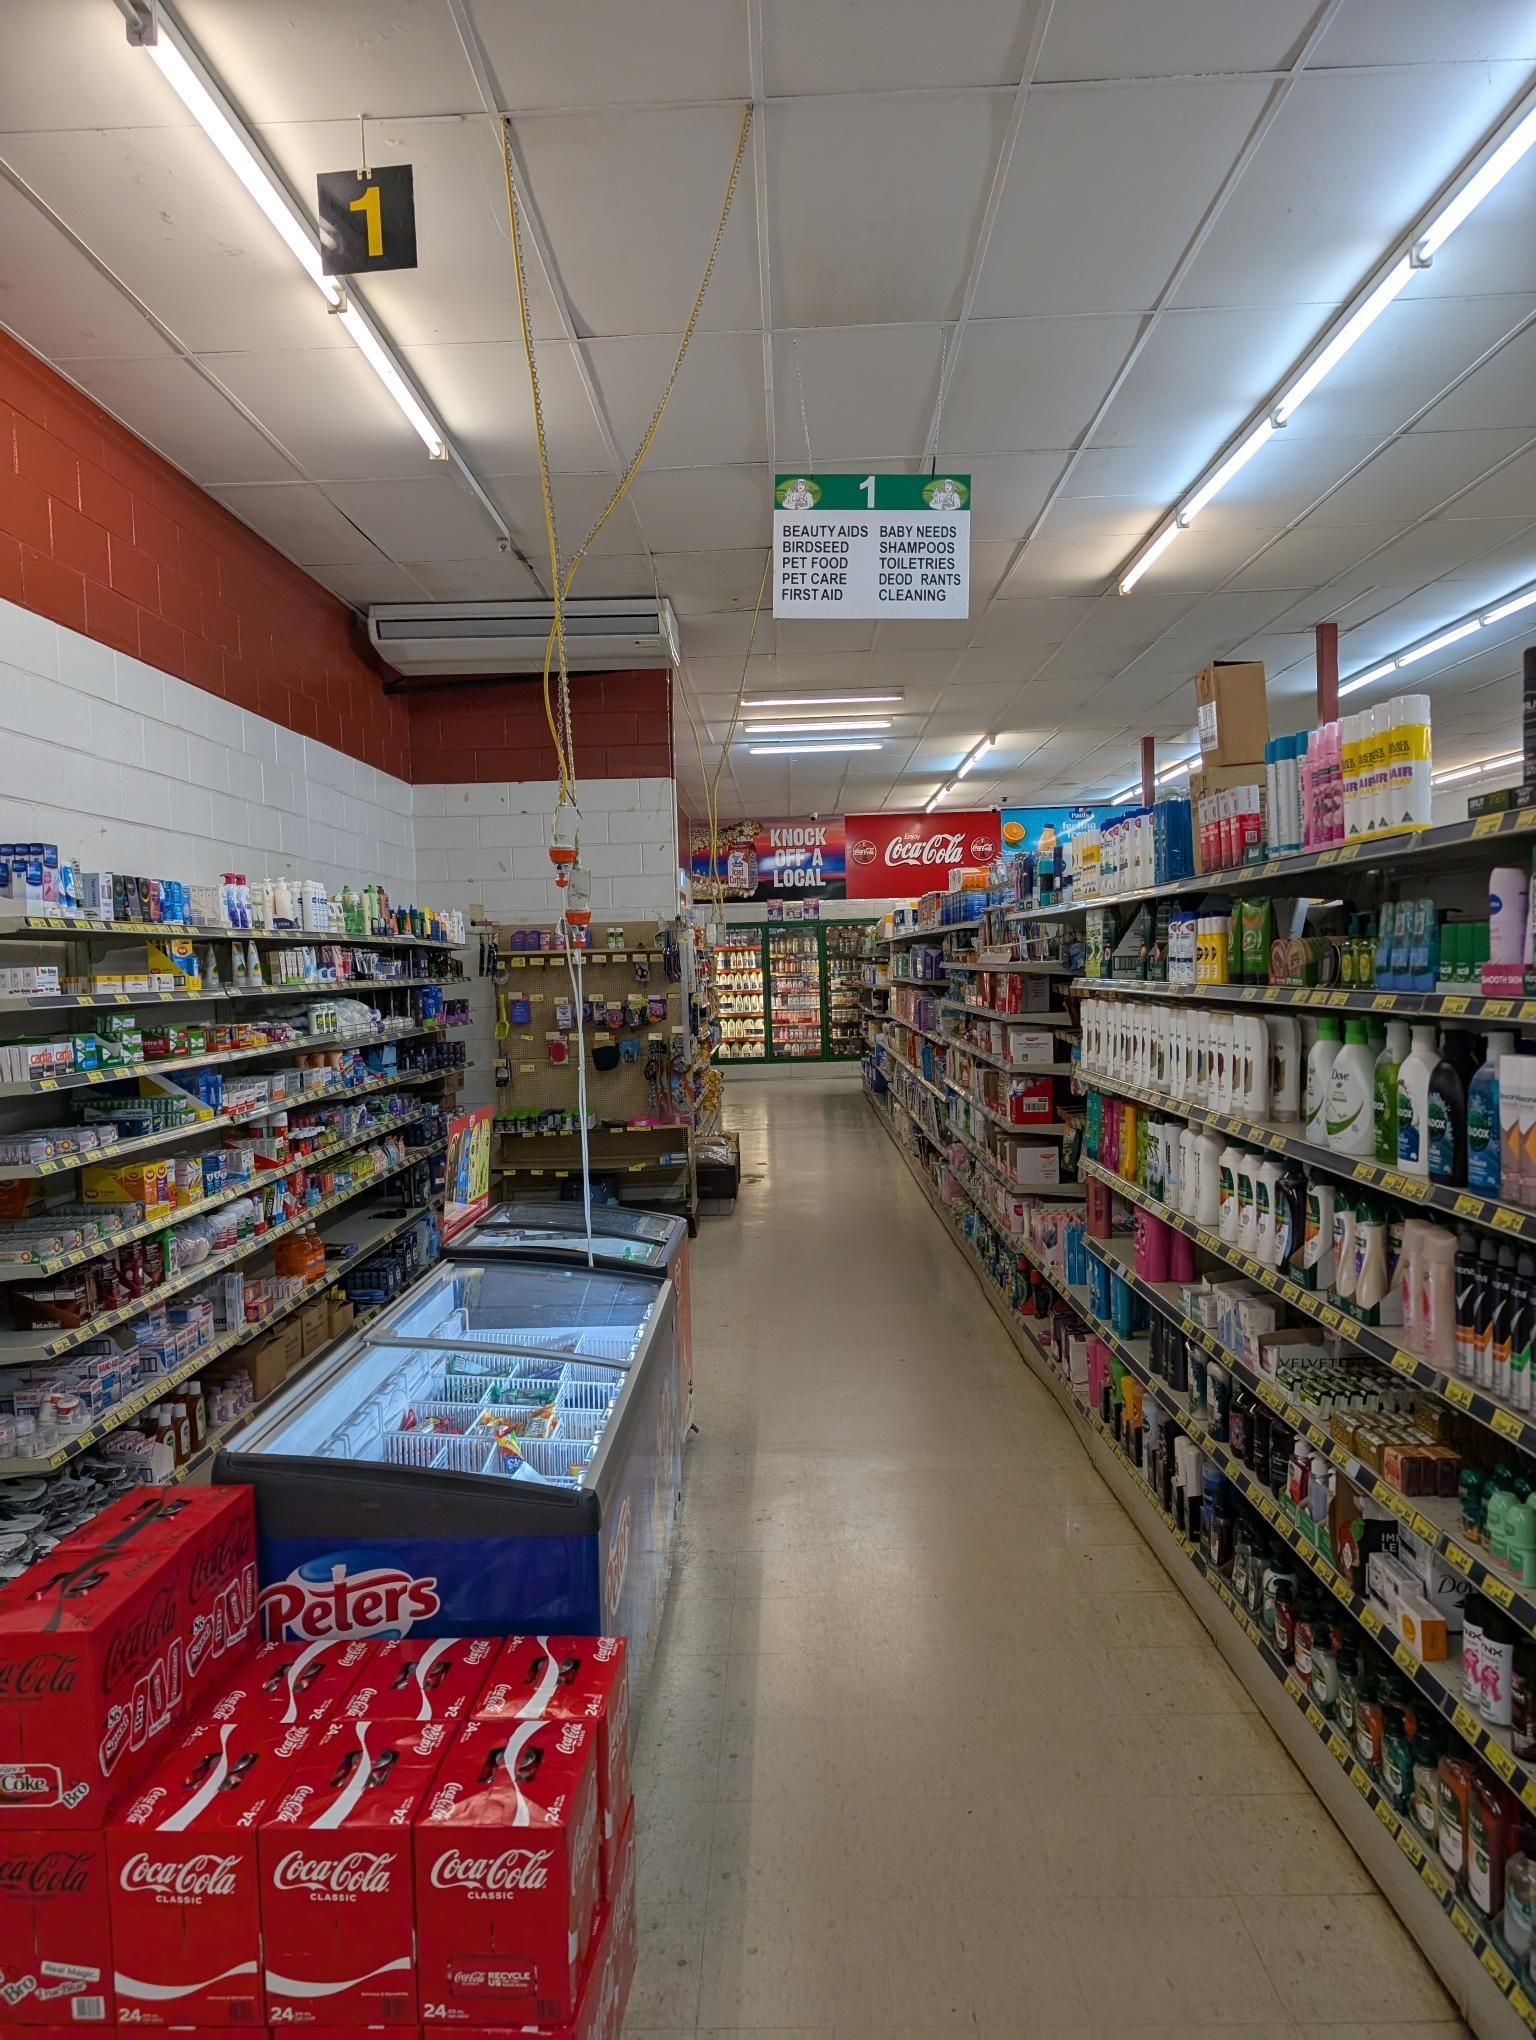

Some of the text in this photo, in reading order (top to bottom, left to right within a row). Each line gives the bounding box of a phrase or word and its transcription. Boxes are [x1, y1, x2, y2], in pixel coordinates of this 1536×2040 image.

[350, 186, 384, 257] 1
[858, 475, 877, 509] 1
[782, 525, 869, 538] BEAUTY AIDS
[879, 525, 957, 538] BABY NEEDS
[782, 541, 850, 554] BIRDSEED
[879, 542, 955, 554] SHAMPOOS
[782, 557, 849, 570] PET FOOD
[879, 557, 955, 570] TOILETRIES
[781, 573, 848, 585] PET CARE
[781, 589, 844, 601] FIRST AID
[878, 589, 947, 602] CLEANING
[770, 828, 827, 847] KNOCK
[904, 832, 921, 841] Enjoy
[884, 832, 966, 867] Coca-Cola
[775, 848, 824, 868] OFF A
[731, 867, 744, 876] Iced
[773, 868, 827, 888] LOCAL
[728, 875, 748, 885] Coffee
[30, 1047, 53, 1065] cartia
[55, 1045, 73, 1063] cartia
[1331, 1070, 1350, 1081] Dove
[32, 1320, 62, 1329] Betadine
[97, 1358, 119, 1373] BAND-AID
[1438, 1574, 1474, 1594] Dov
[258, 1566, 439, 1642] Peters
[555, 1722, 583, 1755] Coca-Cola
[62, 1783, 89, 1808] Bro
[119, 1852, 244, 1895] Coca-Cola
[273, 1850, 398, 1893] Coca-Cola
[430, 1848, 555, 1890] Coca-Cola
[155, 1895, 203, 1905] CLASSIC
[309, 1892, 357, 1902] CLASSIC
[467, 1891, 515, 1900] CLASSIC
[487, 1971, 531, 1981] RECYCLE
[487, 1979, 502, 1987] US
[4, 1976, 36, 2004] Bro
[119, 2008, 142, 2022] 24
[271, 2006, 294, 2021] 24
[423, 2003, 447, 2018] 24
